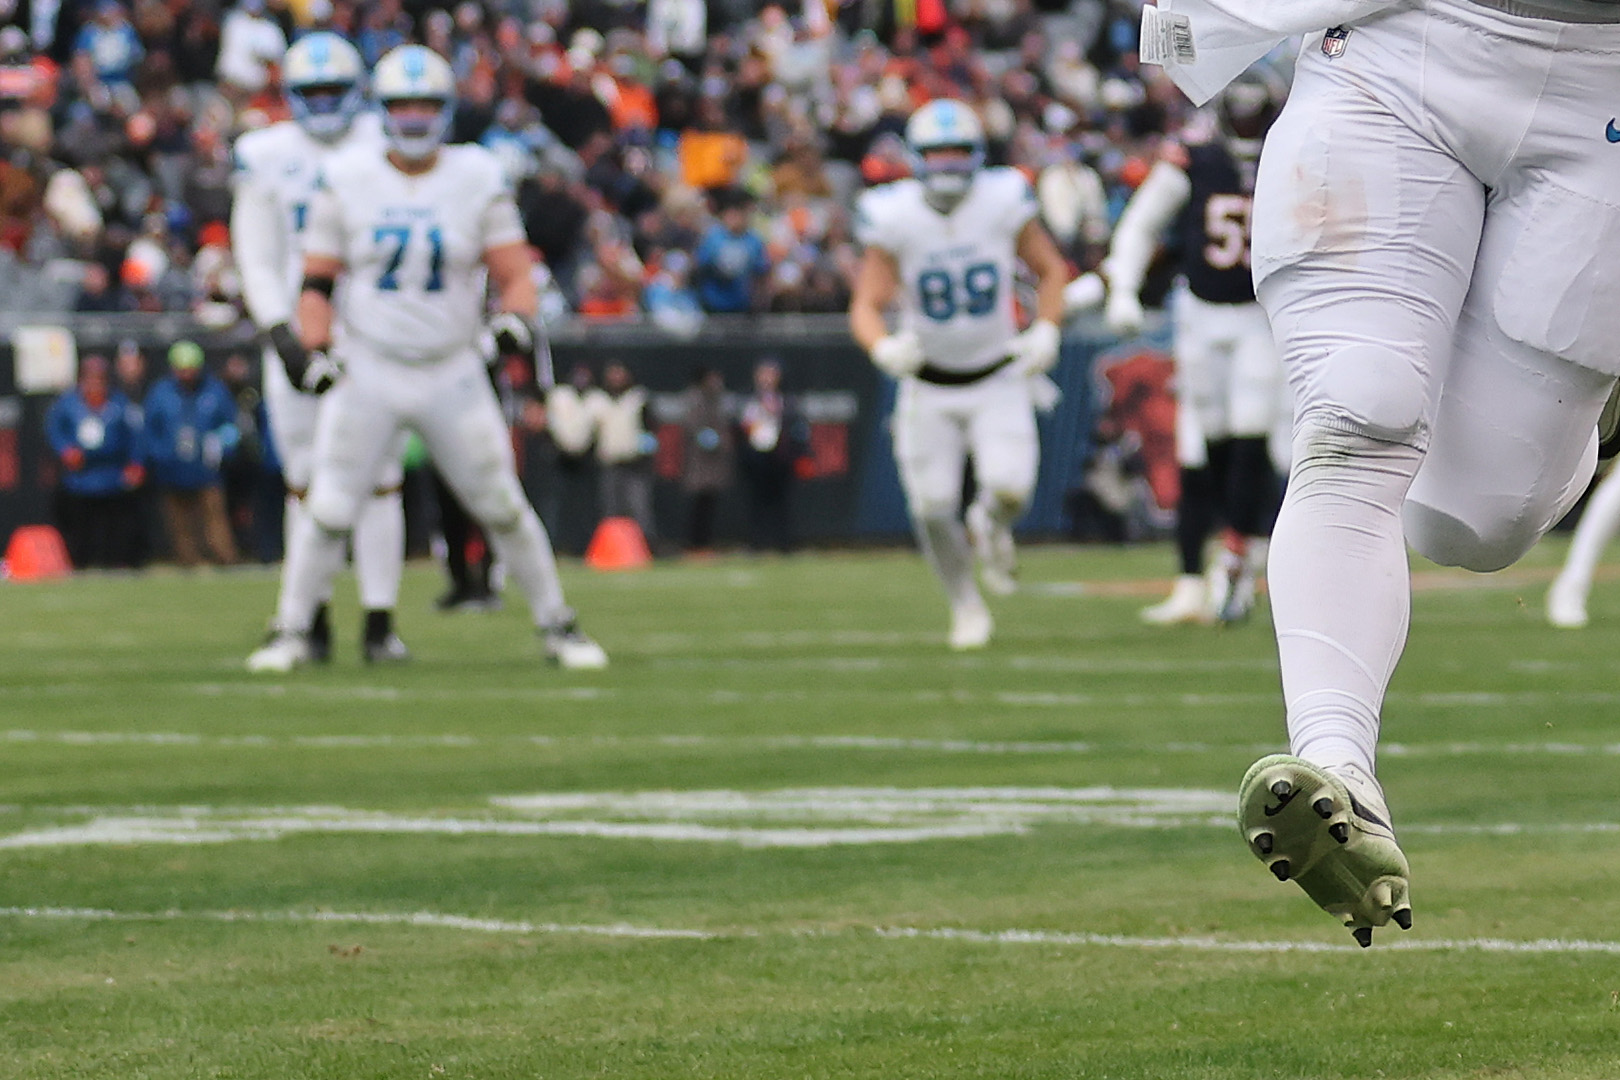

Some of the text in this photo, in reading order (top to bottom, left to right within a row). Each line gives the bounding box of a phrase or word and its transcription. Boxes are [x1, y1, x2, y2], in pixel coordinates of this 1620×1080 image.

[373, 224, 443, 291] 71
[1204, 192, 1253, 271] 5
[919, 263, 999, 320] 89
